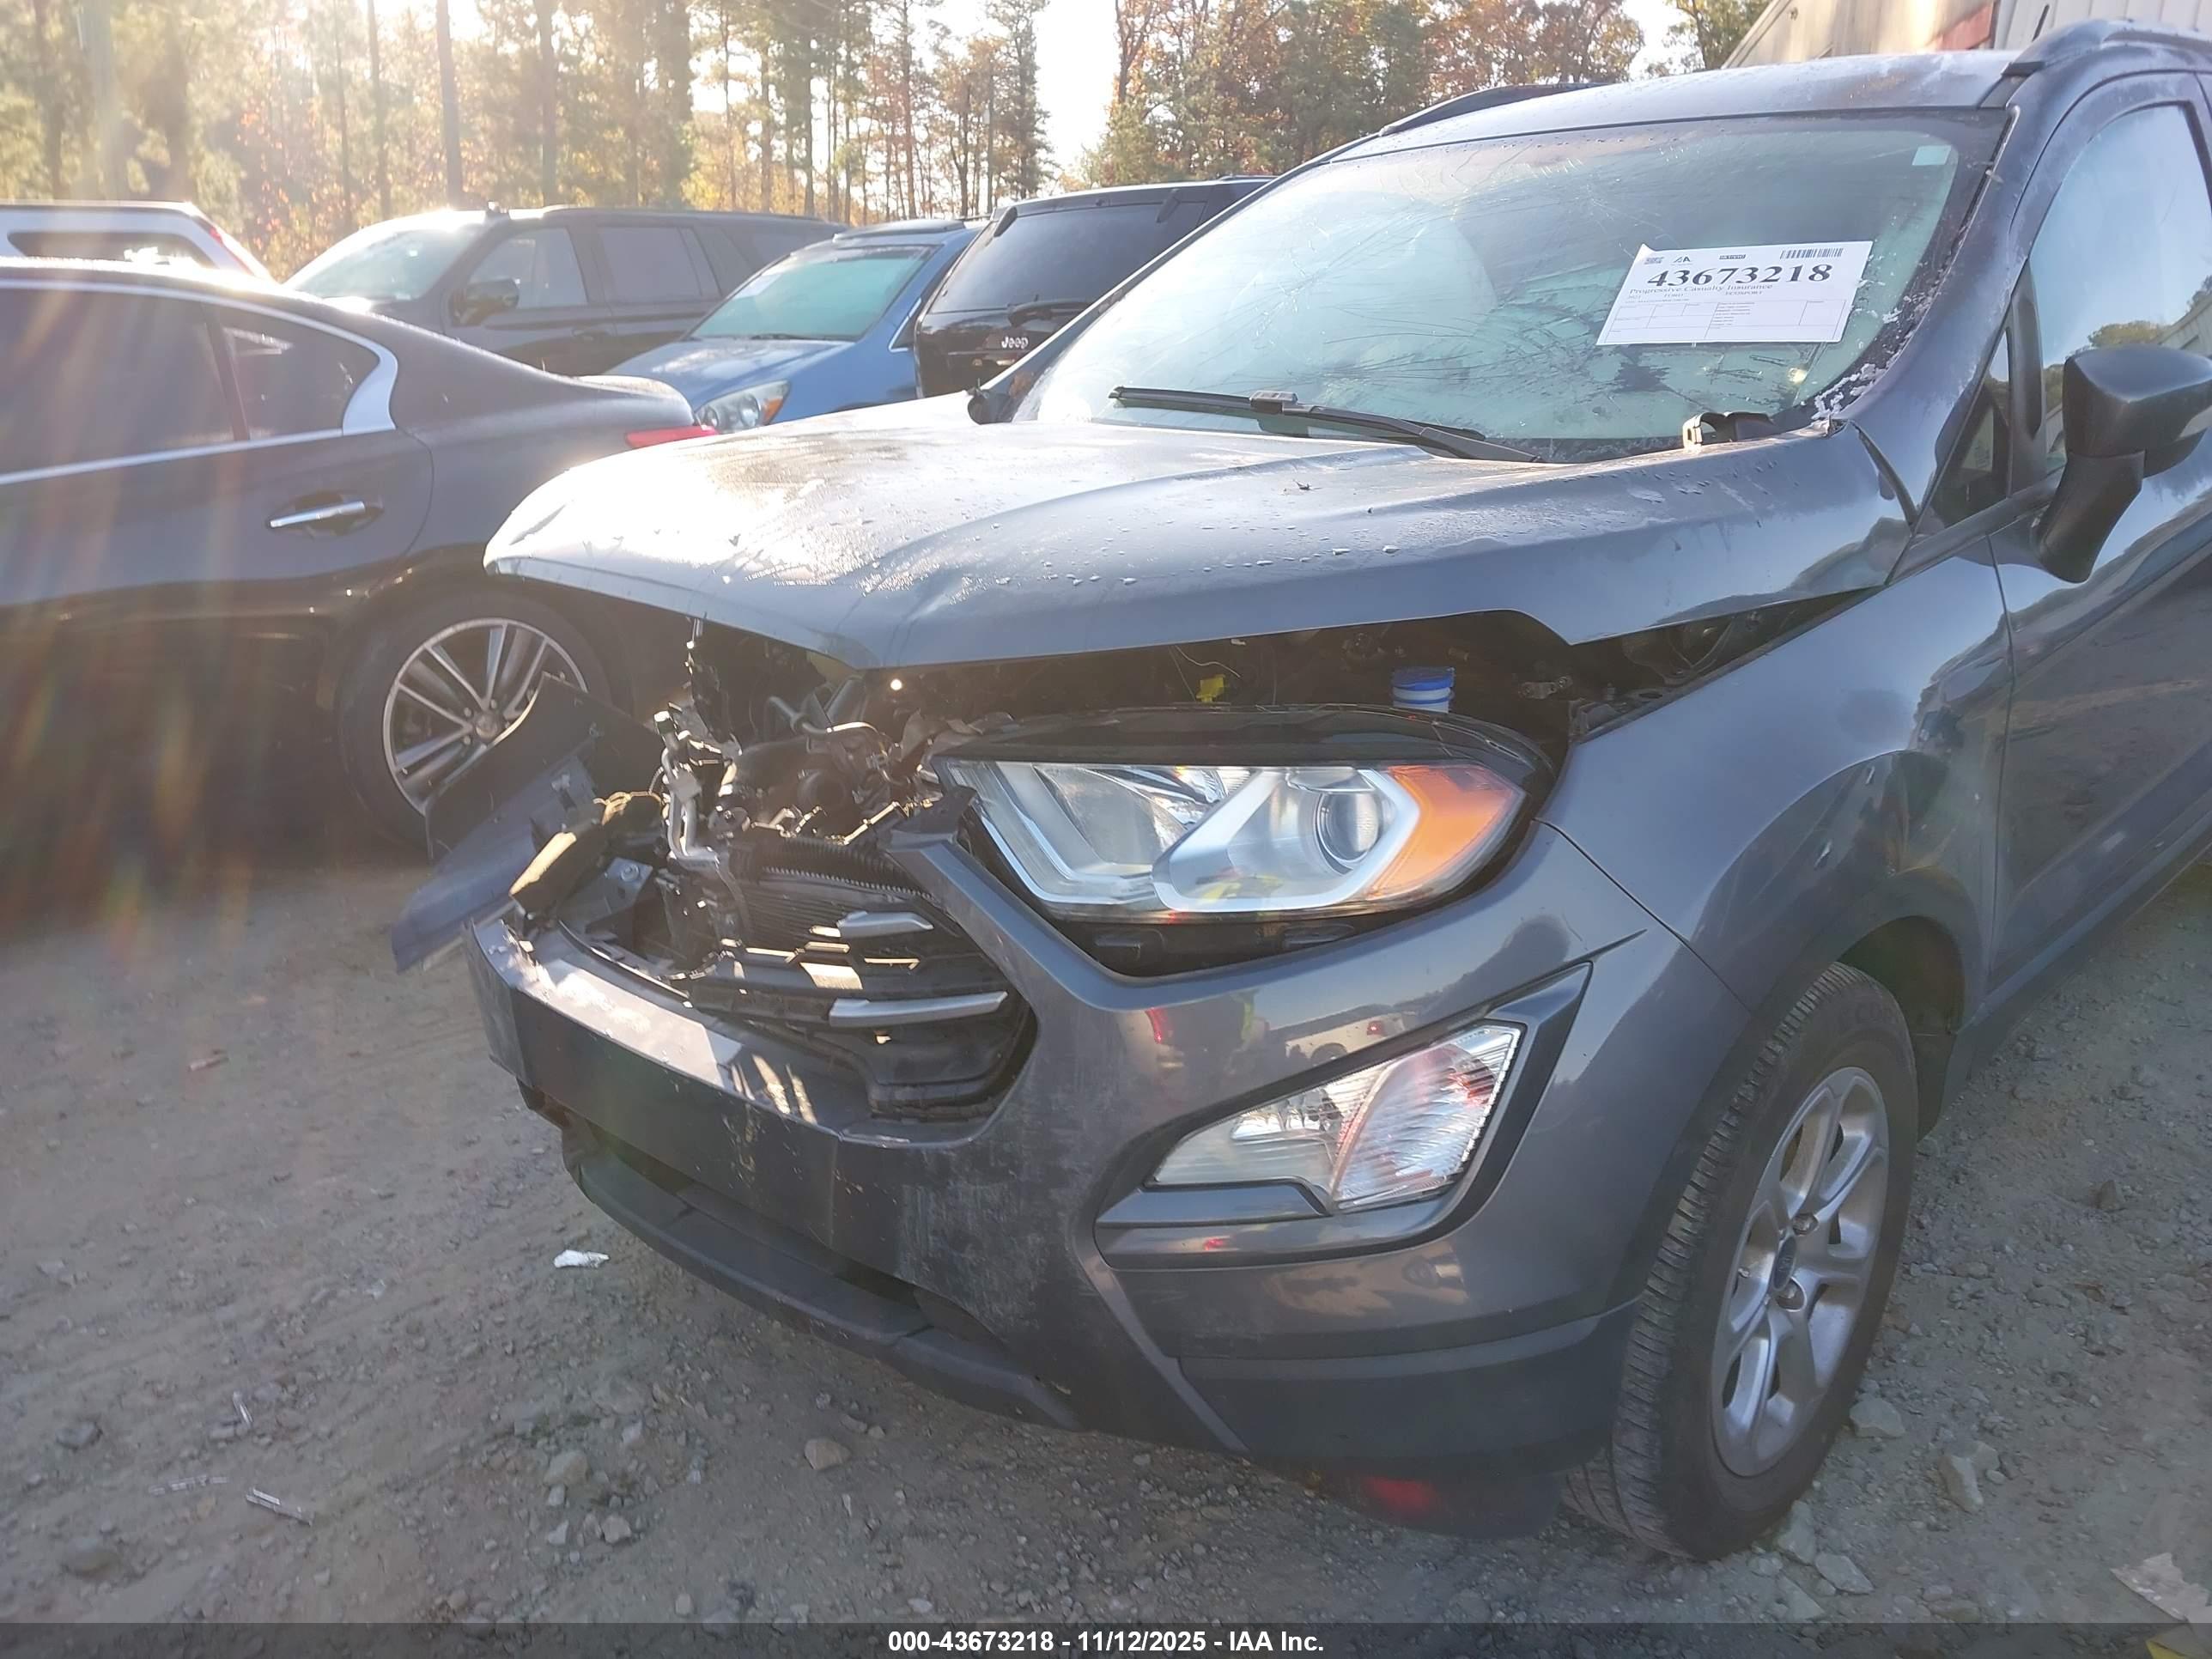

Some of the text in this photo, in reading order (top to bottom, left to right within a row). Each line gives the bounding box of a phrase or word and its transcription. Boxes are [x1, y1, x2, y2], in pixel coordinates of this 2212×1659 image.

[1646, 264, 1833, 287] 43673218
[1683, 284, 1723, 293] Casualty
[1001, 336, 1029, 349] Jeep
